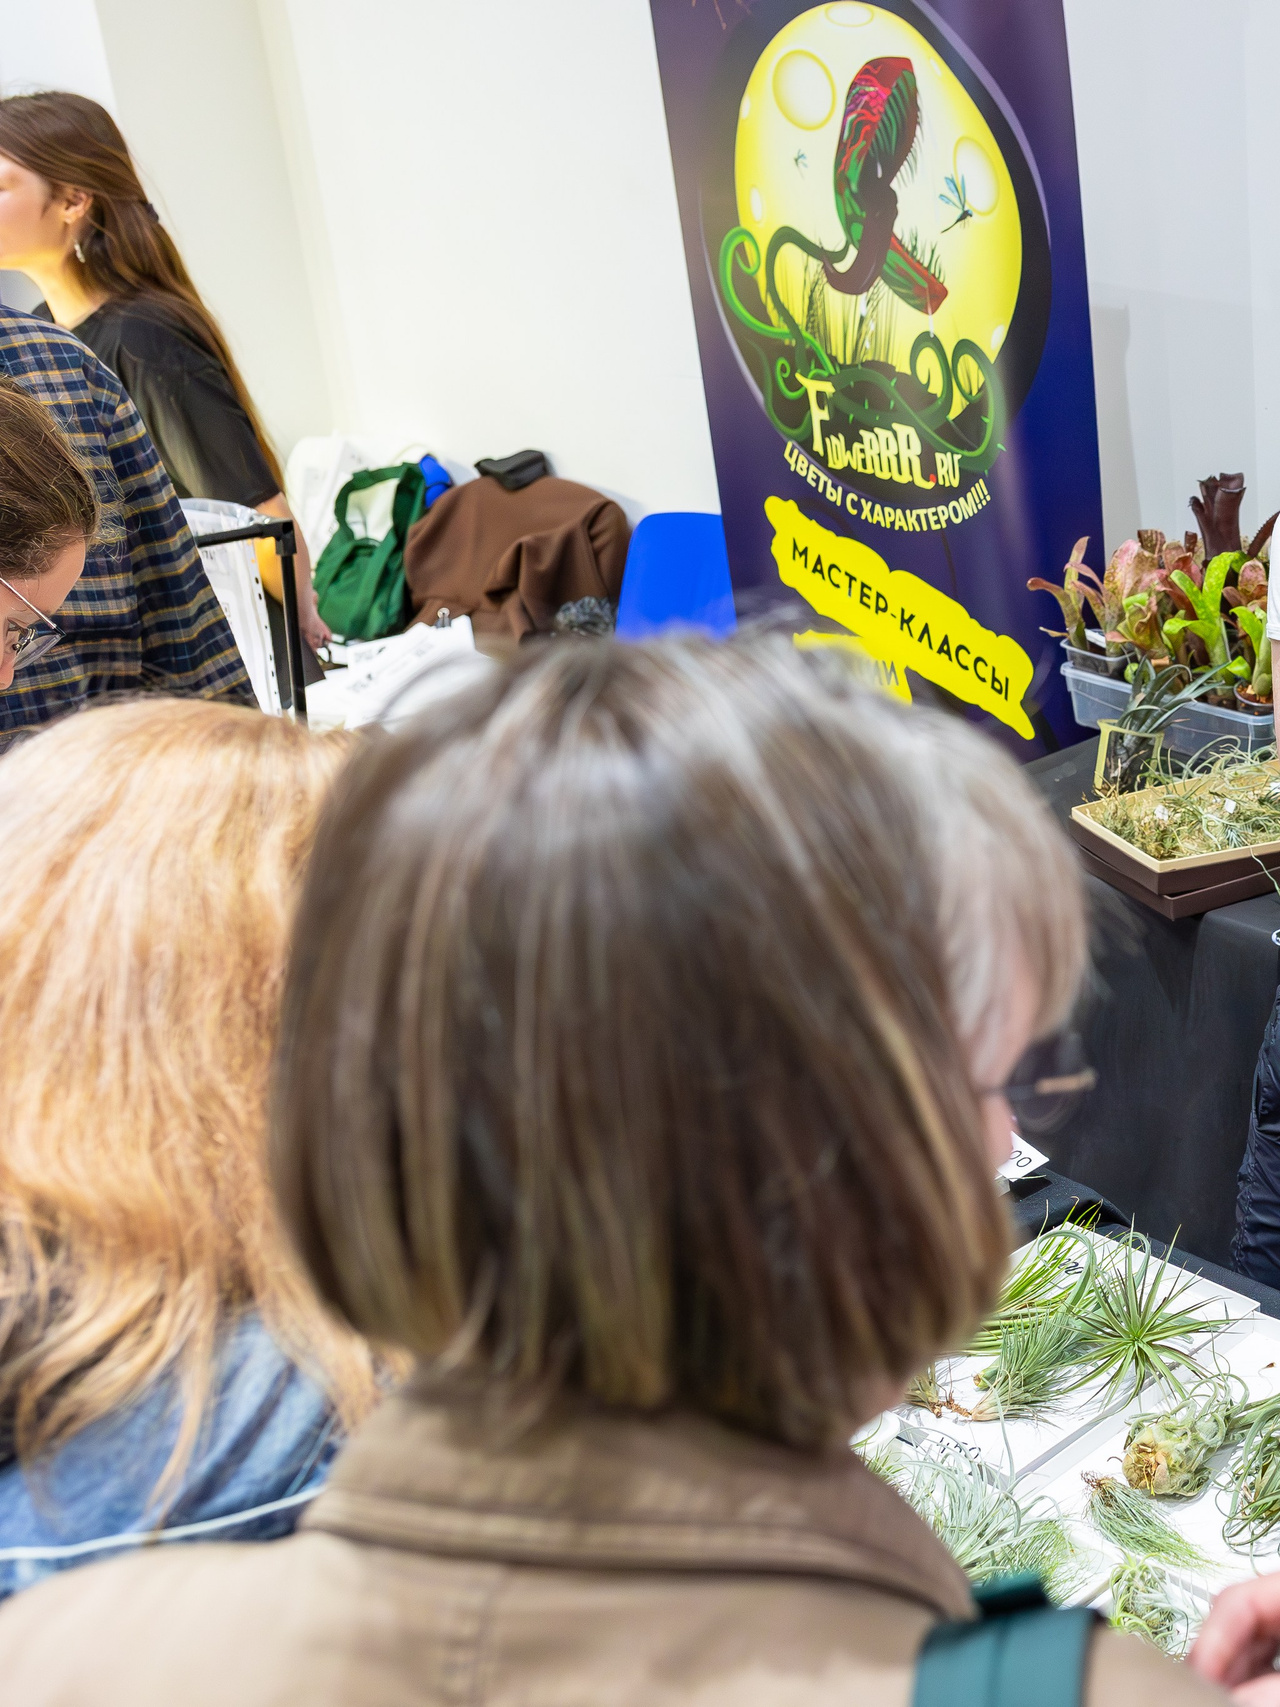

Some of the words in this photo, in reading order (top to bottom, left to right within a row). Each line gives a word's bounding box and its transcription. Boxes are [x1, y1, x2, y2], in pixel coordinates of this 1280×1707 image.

[784, 440, 843, 506] ЦВЕТЫ
[846, 493, 858, 516] С
[861, 478, 991, 532] ХАРАКТЕРОМ!!!
[792, 537, 1009, 701] МАСТЕР-КЛАССЫ
